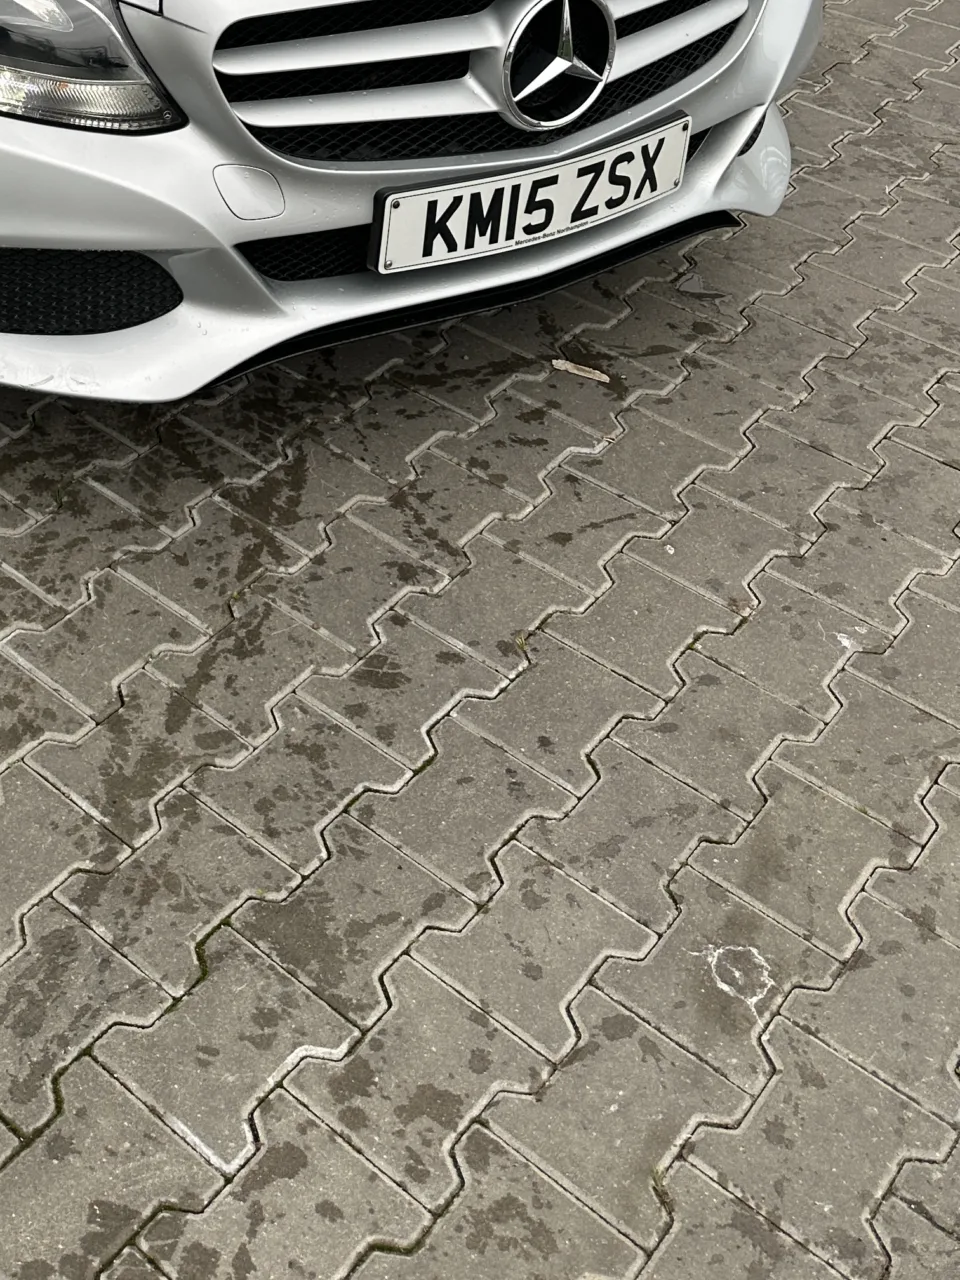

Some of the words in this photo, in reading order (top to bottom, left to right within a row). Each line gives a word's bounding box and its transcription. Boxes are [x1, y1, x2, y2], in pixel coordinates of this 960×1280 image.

[421, 174, 559, 257] KM15
[570, 136, 665, 223] ZSX
[514, 231, 556, 246] Mercedes-Benz
[556, 221, 589, 235] Northampton
